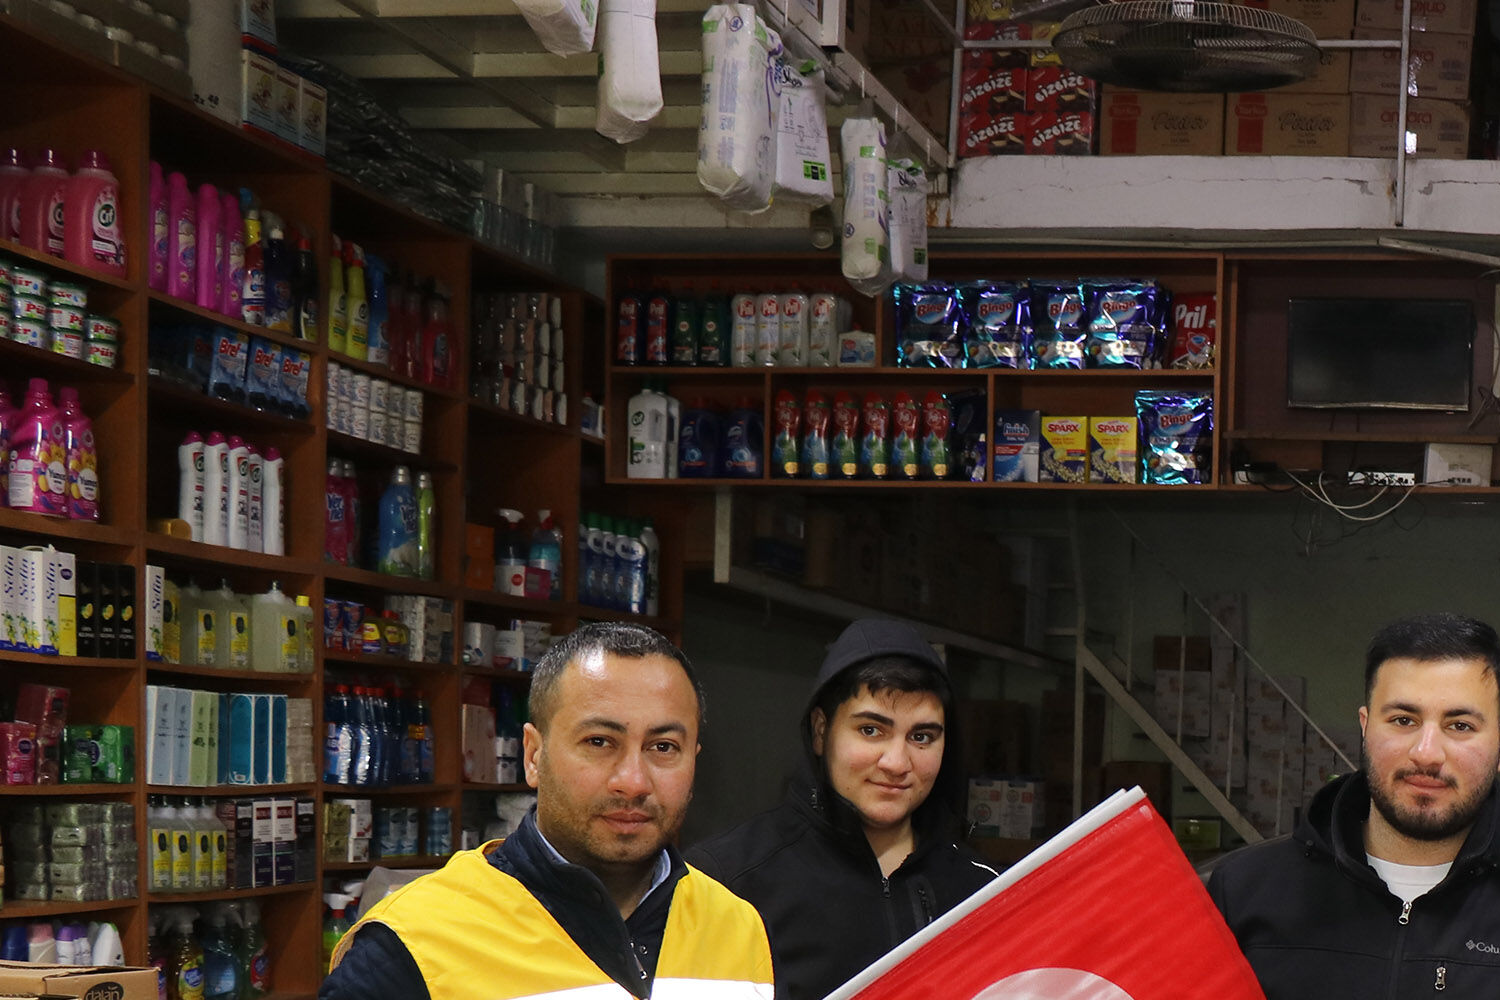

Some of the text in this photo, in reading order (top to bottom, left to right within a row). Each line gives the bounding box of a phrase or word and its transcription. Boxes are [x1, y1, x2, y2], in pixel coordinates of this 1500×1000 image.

[978, 301, 1012, 317] Bingo
[1176, 304, 1207, 329] Pril
[219, 338, 241, 357] Bref
[254, 349, 274, 367] Bref
[1047, 423, 1079, 434] SPARX
[1097, 423, 1129, 434] SPARX
[1160, 413, 1192, 428] Bingo
